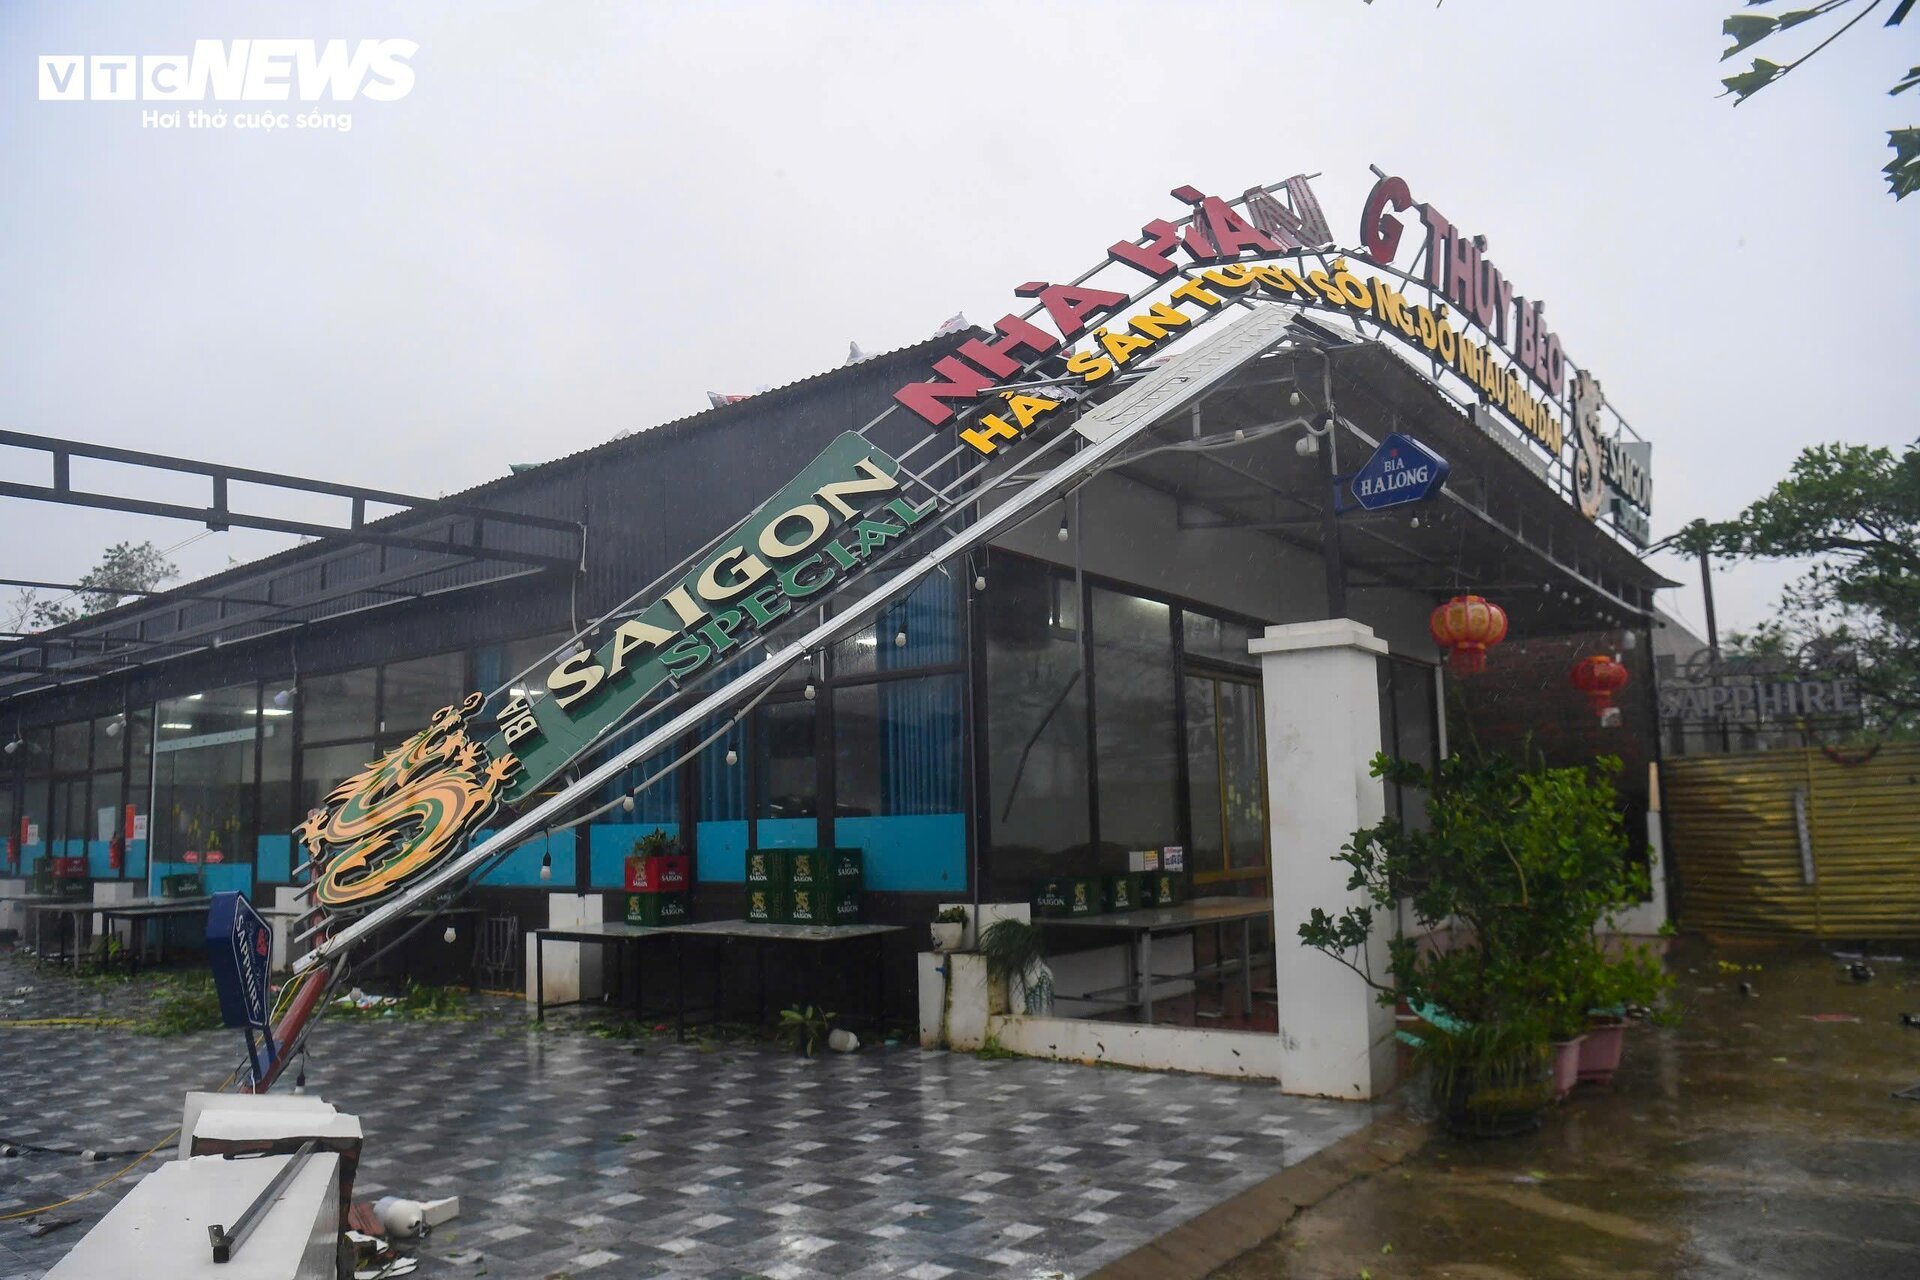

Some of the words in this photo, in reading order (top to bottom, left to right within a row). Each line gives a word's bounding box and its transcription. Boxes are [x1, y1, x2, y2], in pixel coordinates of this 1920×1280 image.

[1384, 458, 1405, 473] BIA
[496, 695, 538, 746] BIA
[546, 456, 900, 711] SAIGON
[657, 497, 940, 680] SPECIAL
[1658, 678, 1858, 718] SAPPHIRE
